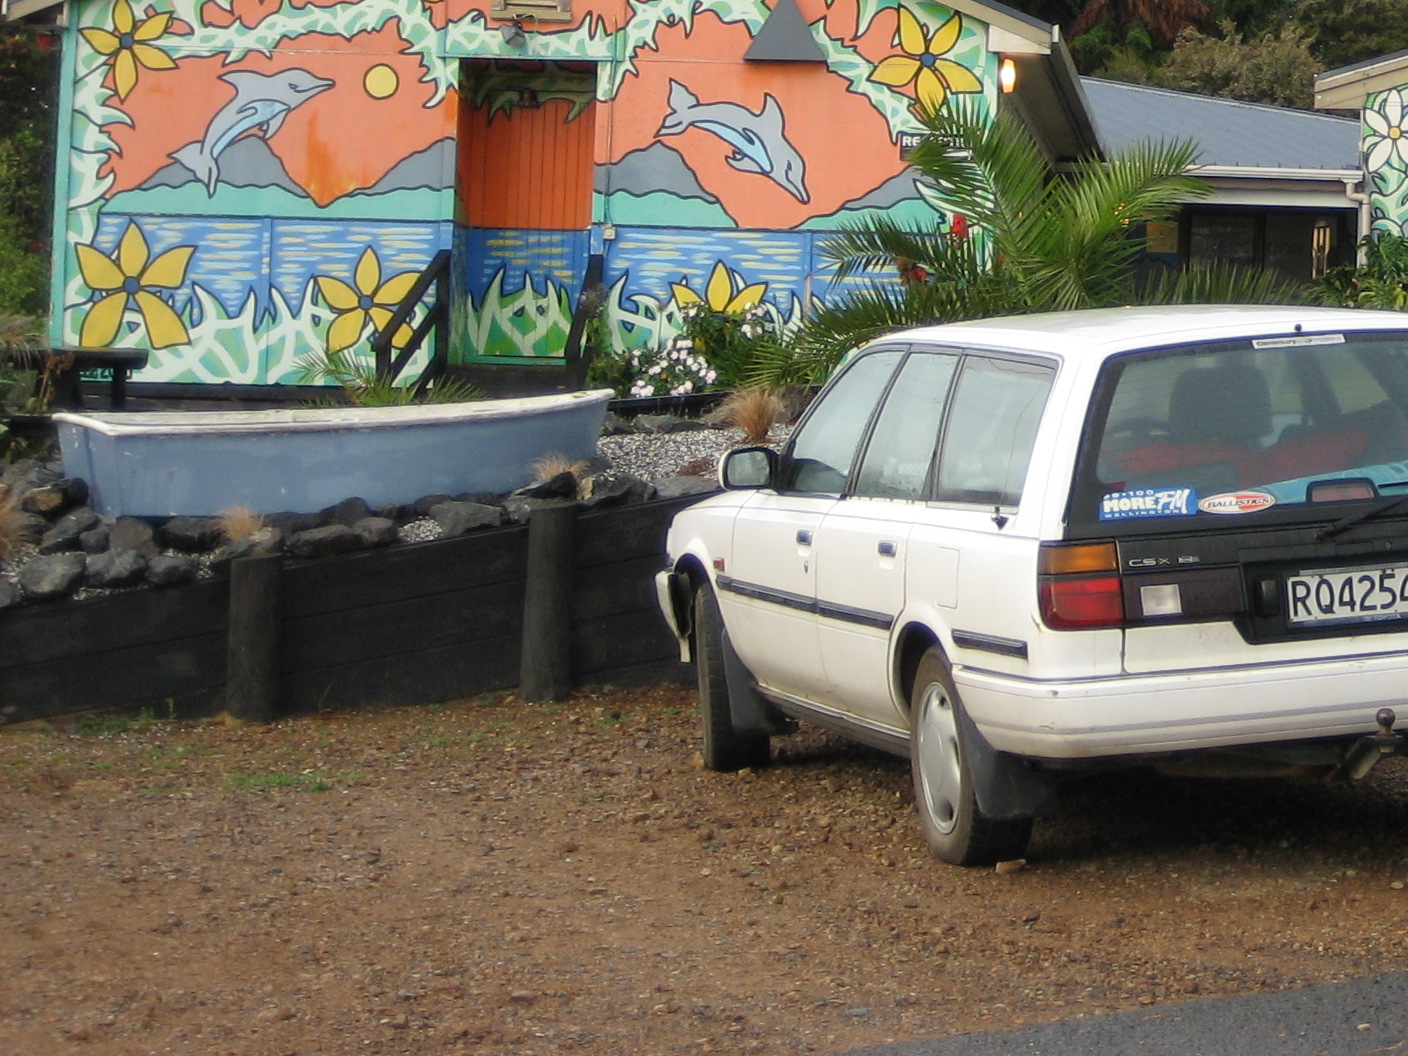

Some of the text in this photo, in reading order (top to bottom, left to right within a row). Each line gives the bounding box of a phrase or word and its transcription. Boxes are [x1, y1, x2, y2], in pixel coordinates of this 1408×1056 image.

[1103, 489, 1190, 514] MORE FM
[1128, 556, 1170, 567] CSX
